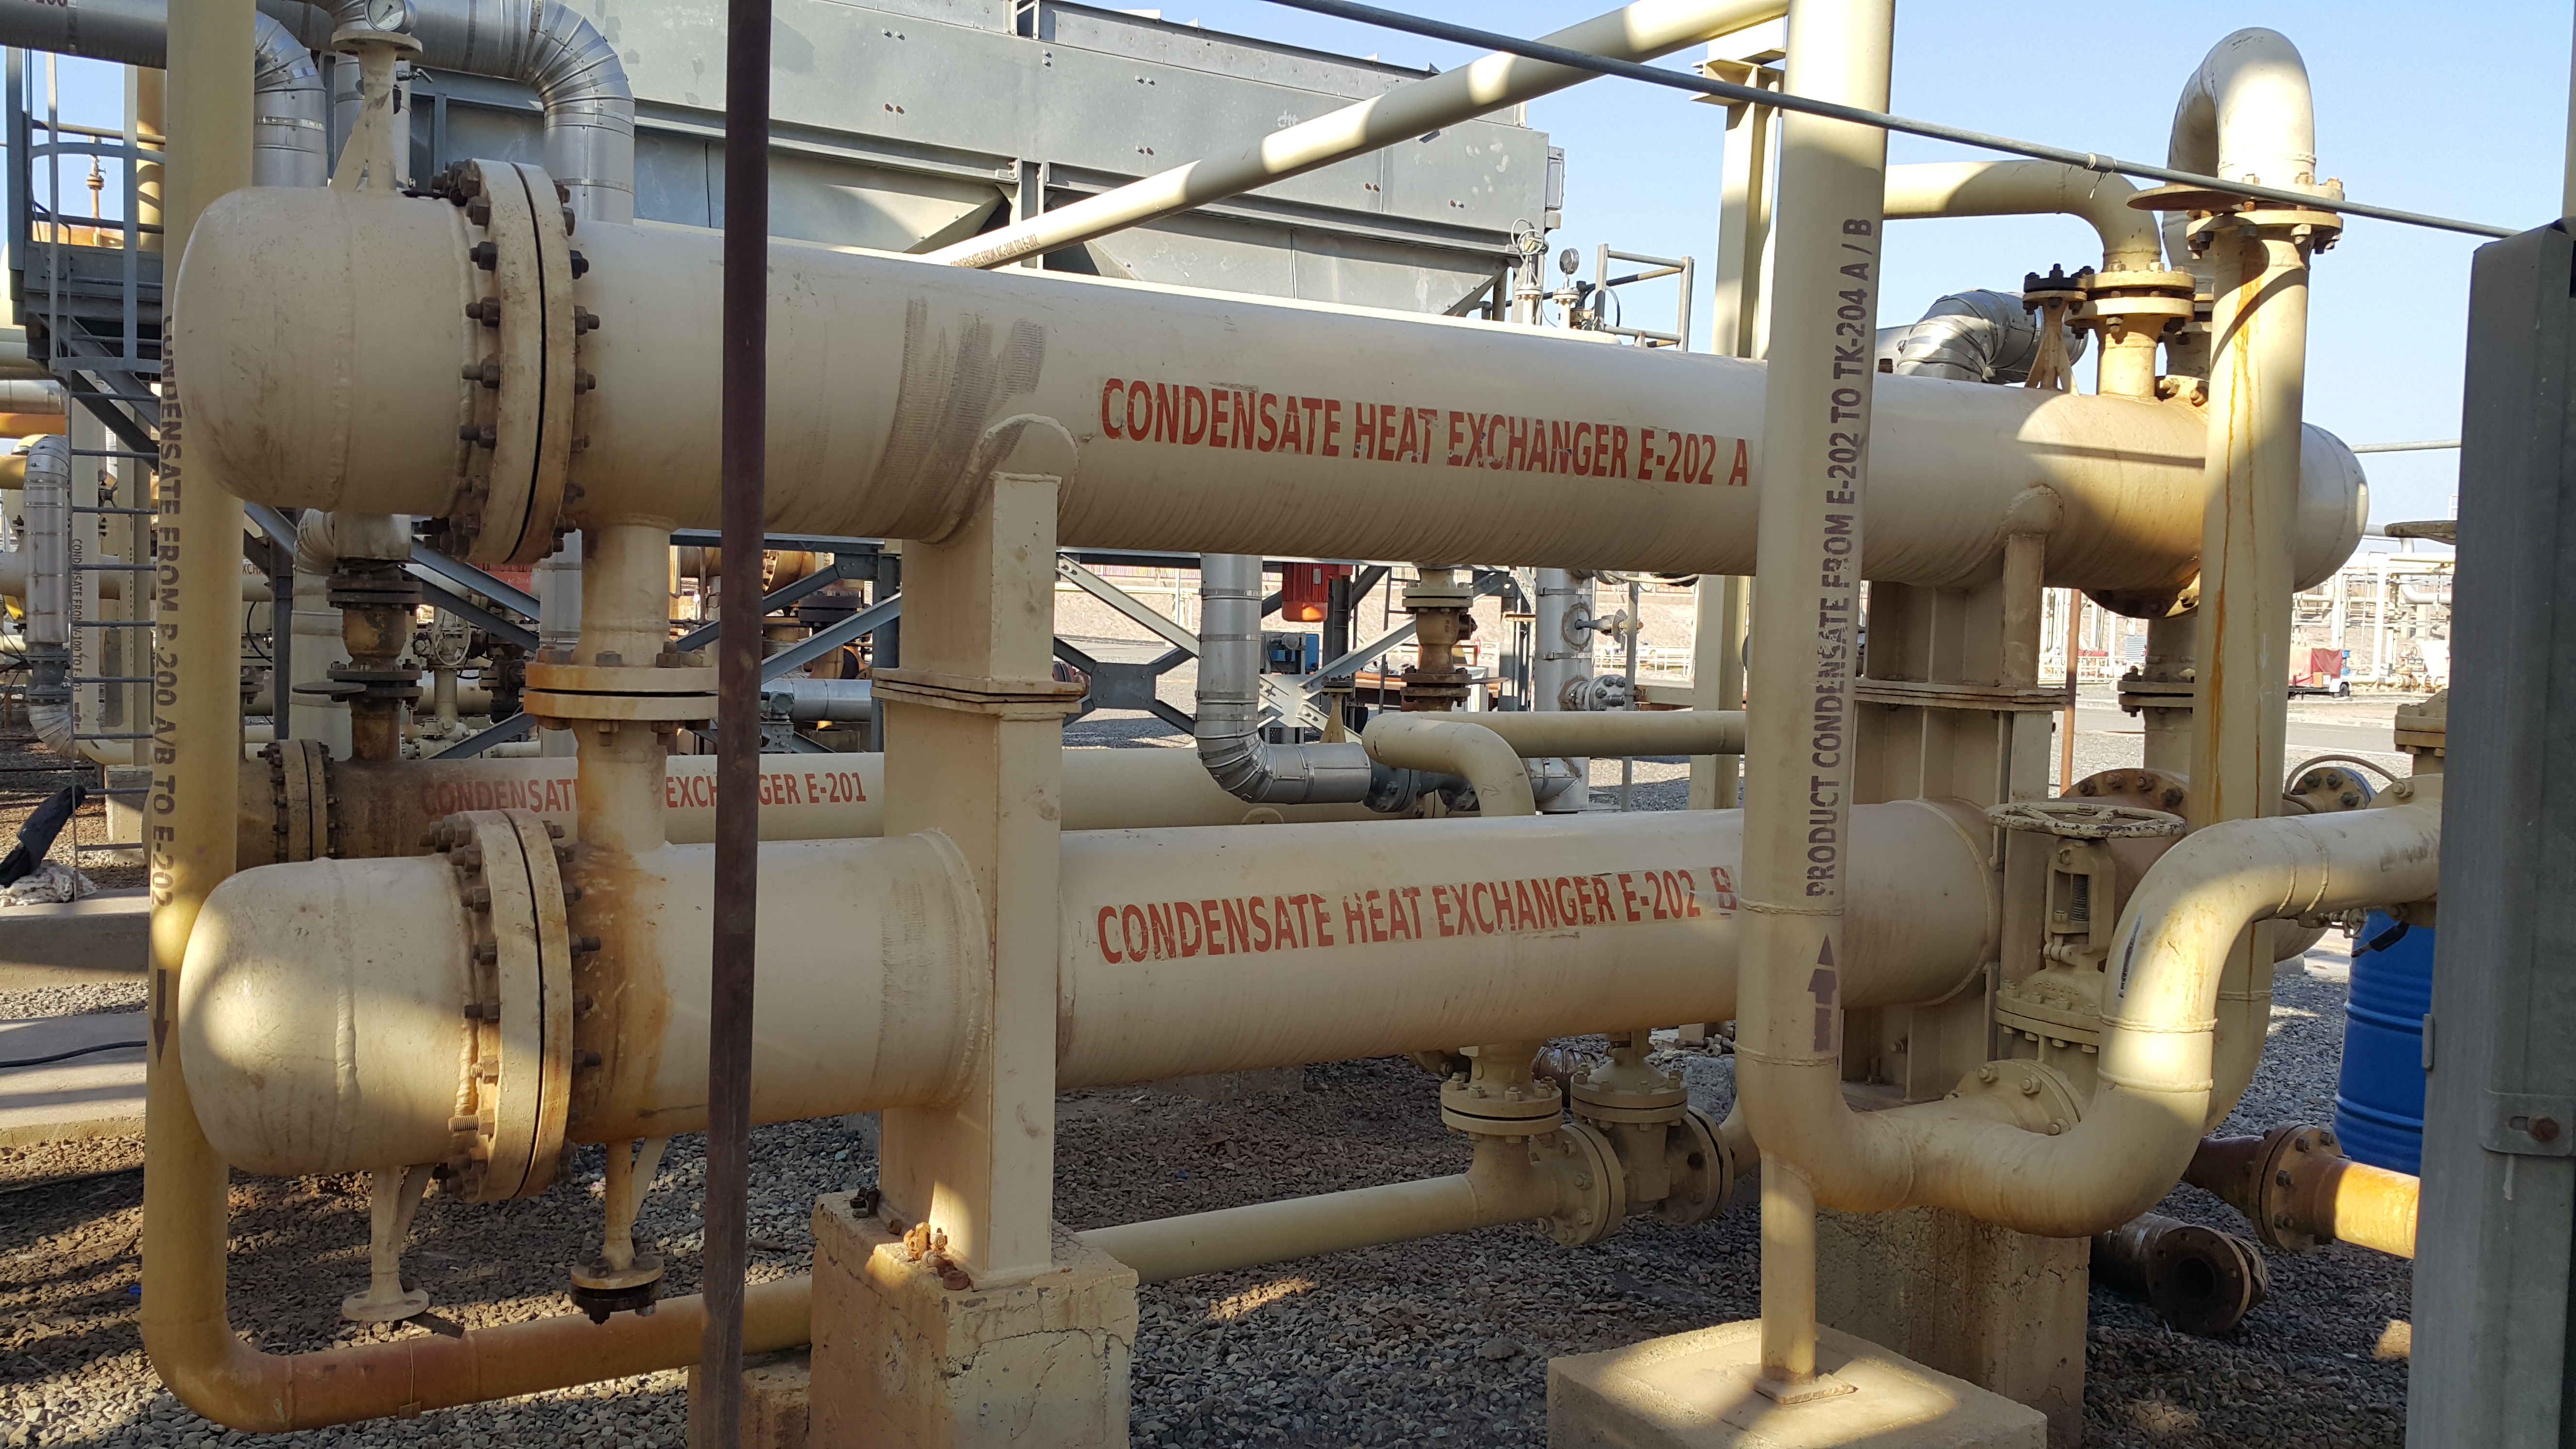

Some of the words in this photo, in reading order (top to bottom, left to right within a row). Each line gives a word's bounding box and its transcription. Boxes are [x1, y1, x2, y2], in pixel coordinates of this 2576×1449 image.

[1834, 289, 1868, 379] TK-204
[1102, 378, 1341, 457] CONDENSATE
[1352, 402, 1438, 464] HEAT
[1447, 411, 1628, 478] EXCHANGER
[1638, 428, 1716, 484] E-202
[1728, 438, 1748, 486] A
[1831, 388, 1861, 423] TO
[1826, 433, 1859, 504] E-202
[73, 538, 83, 596] CONDNSATE
[158, 527, 180, 612] FROM
[1821, 515, 1853, 588] FROM
[1812, 597, 1850, 768] CONDENSATE
[153, 715, 177, 765] A/B
[153, 775, 176, 815] TO
[666, 773, 801, 808] EXCHGER
[805, 772, 867, 804] E-201
[151, 825, 175, 907] E-202
[1806, 775, 1840, 896] PRODUCT
[1097, 893, 1334, 964] CONDENSATE
[1343, 886, 1422, 945] HEAT
[1432, 876, 1616, 937] EXCHANGER
[1617, 869, 1701, 922] E-202
[1709, 867, 1738, 916] B
